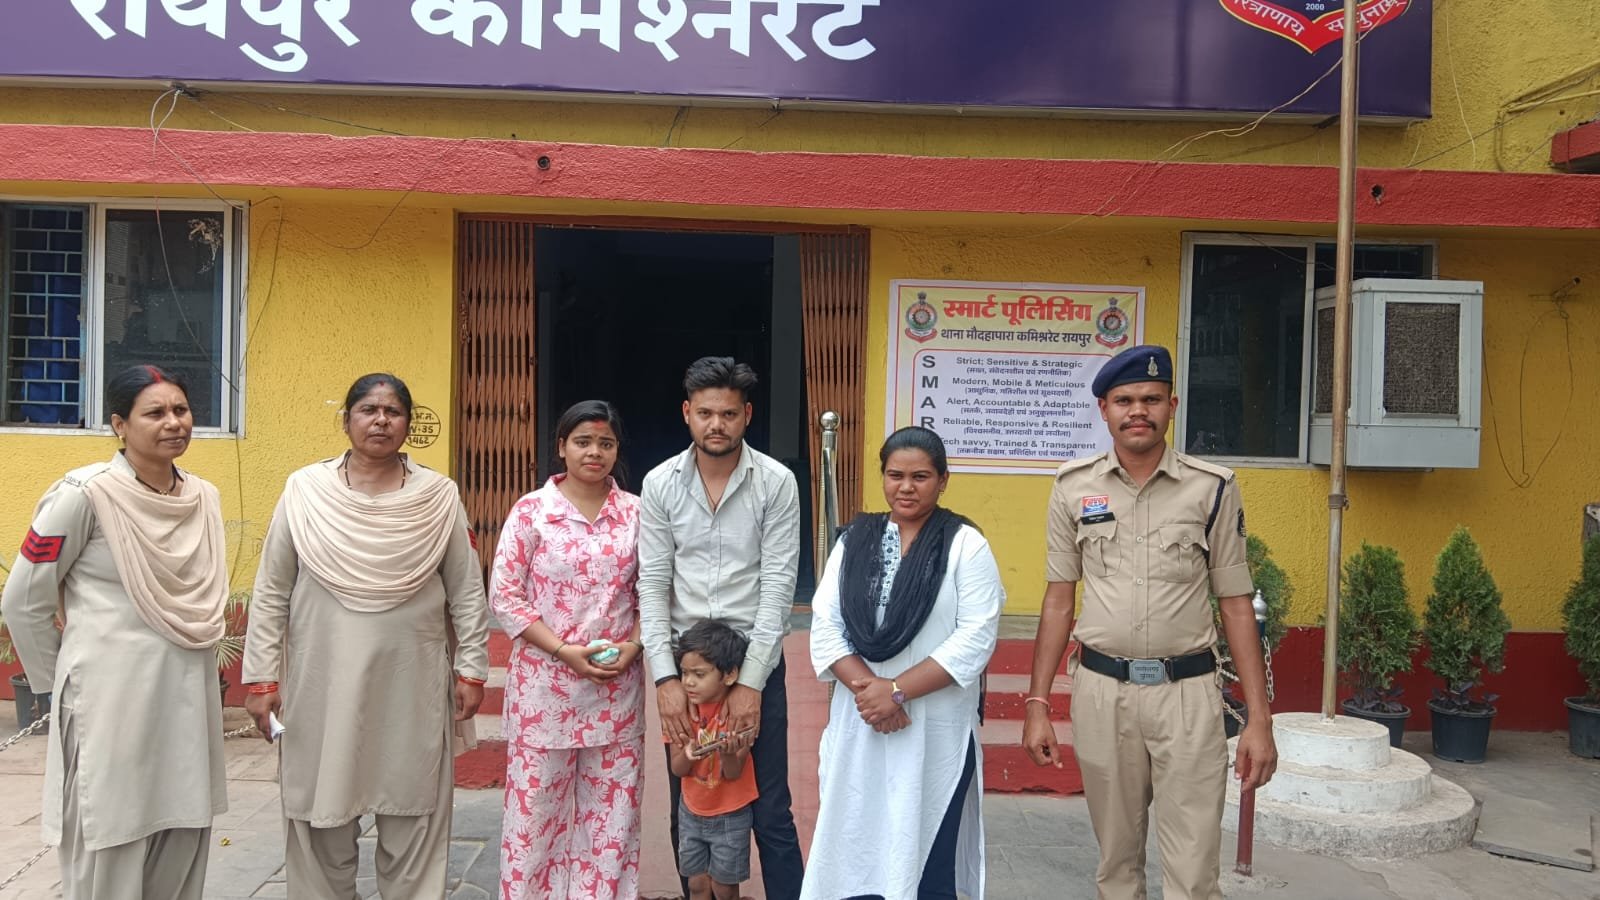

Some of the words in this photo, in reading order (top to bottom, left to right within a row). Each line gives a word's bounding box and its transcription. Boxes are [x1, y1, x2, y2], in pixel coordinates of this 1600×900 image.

[1305, 3, 1325, 11] 2000
[410, 0, 881, 62] कमिश्नरट
[943, 294, 998, 318] स्मार्ट
[1001, 295, 1093, 325] पूलिसिंग
[941, 329, 964, 340] थाना
[966, 326, 1014, 341] मौदहापारा
[1062, 332, 1092, 348] रायपुर
[922, 355, 936, 368] S
[986, 358, 1029, 367] Sensitive
[1041, 360, 1083, 369] Strategic
[922, 375, 939, 388] M
[952, 377, 989, 386] Modern,
[992, 378, 1023, 387] Mobile
[1035, 379, 1086, 389] Meticulous
[920, 396, 936, 409] A
[946, 397, 971, 406] Alert,
[973, 398, 1031, 407] Accountable
[1034, 400, 1041, 408] &
[1043, 400, 1091, 409] Adaptable
[921, 416, 936, 430] R
[943, 417, 983, 426] Reliable,
[986, 419, 1040, 428] Responsive
[1052, 421, 1093, 429] Resilient
[963, 439, 991, 448] savvy,
[994, 439, 1028, 448] Trained
[1031, 440, 1038, 448] &
[1040, 441, 1097, 450] Transparent
